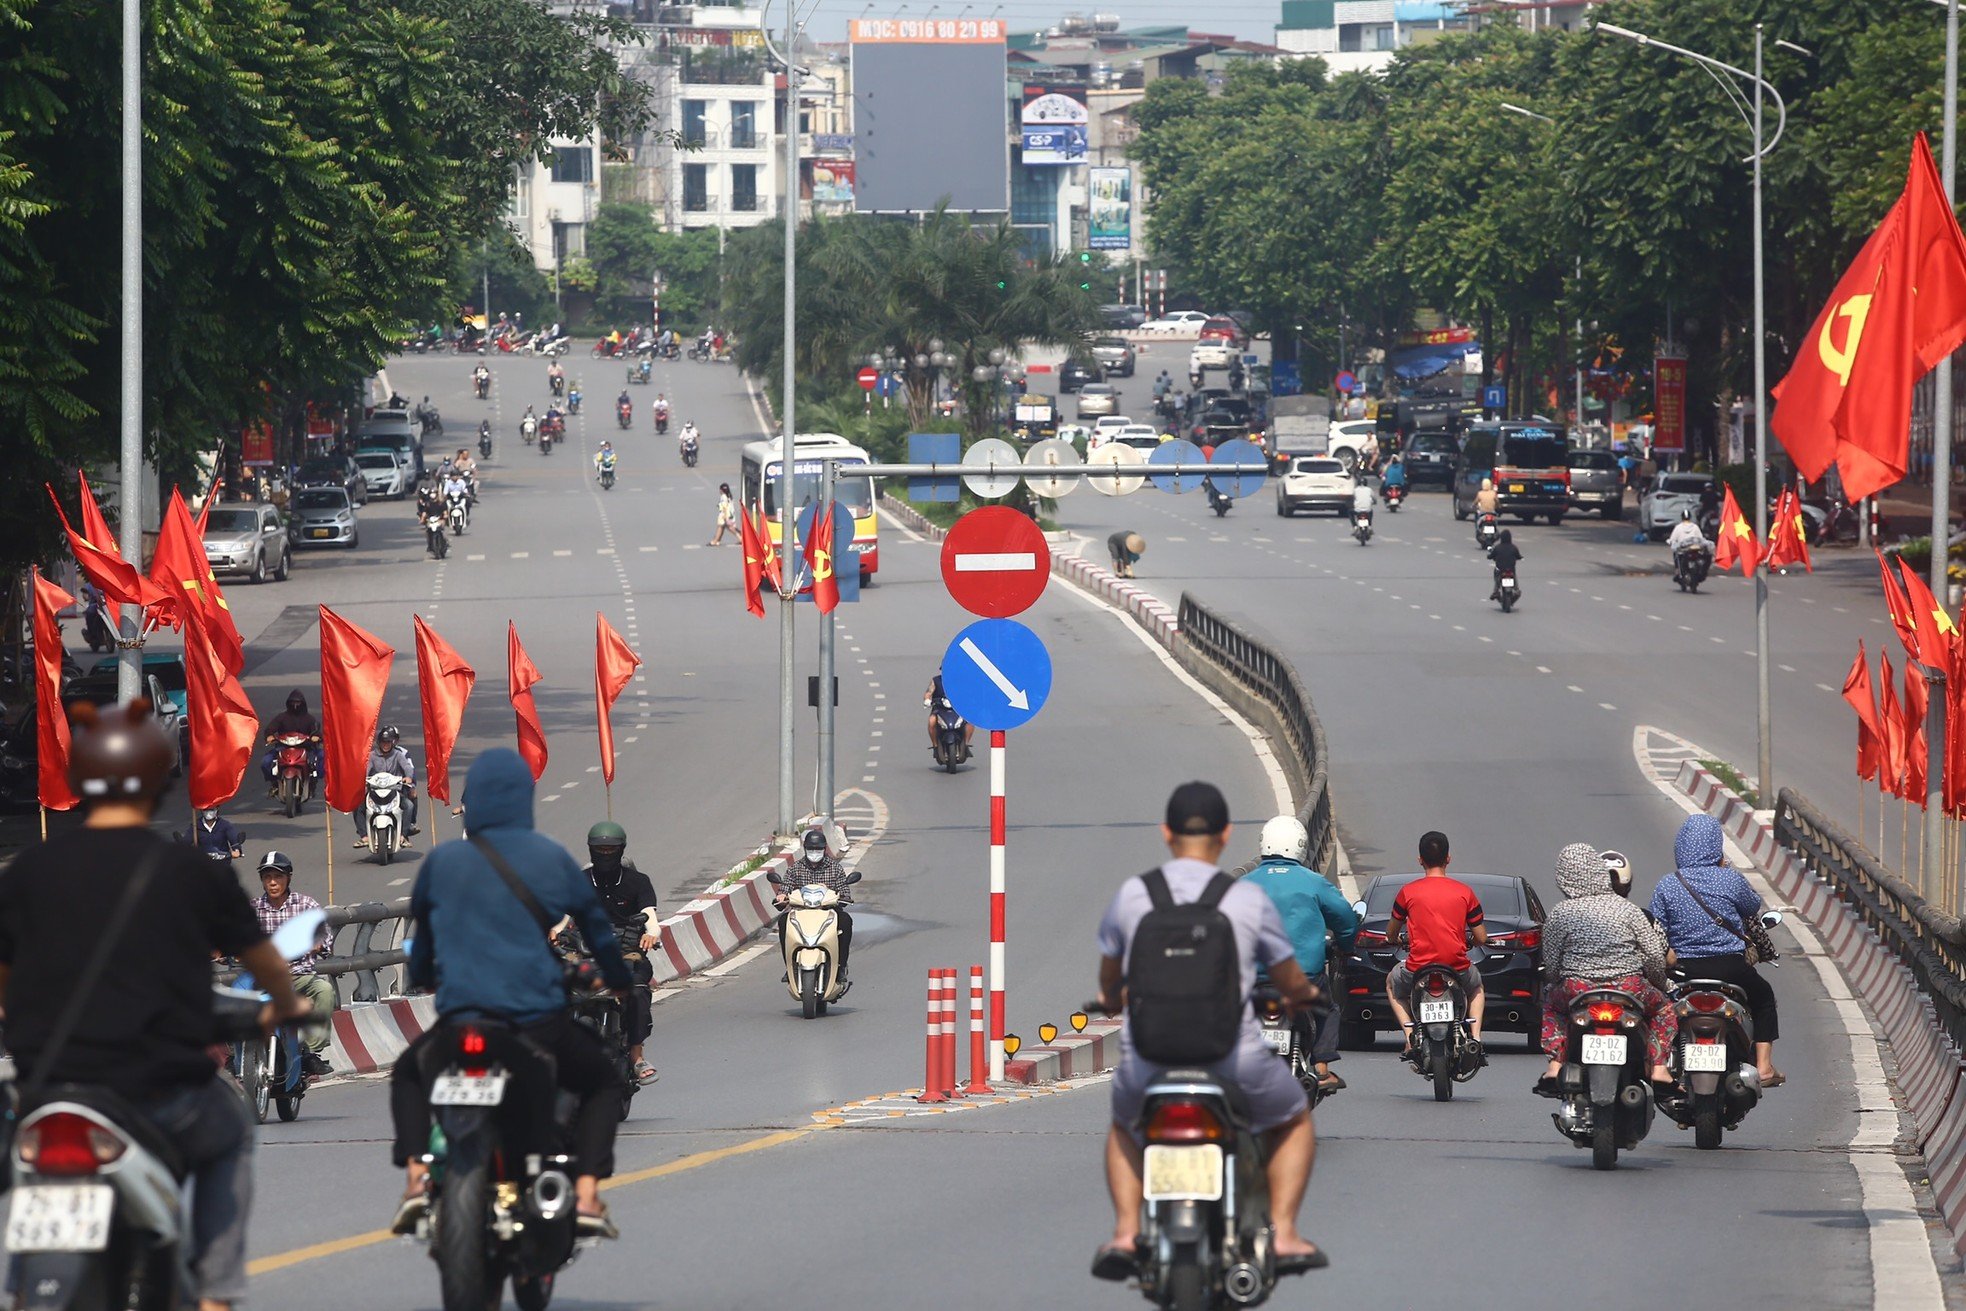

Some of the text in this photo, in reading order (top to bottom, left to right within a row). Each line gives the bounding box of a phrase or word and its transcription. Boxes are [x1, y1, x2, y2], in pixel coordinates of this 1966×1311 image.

[900, 20, 935, 38] 0916
[959, 20, 977, 38] 20
[980, 20, 999, 38] 99
[1424, 1002, 1449, 1012] 30-M1
[1424, 1012, 1449, 1021] 0363
[1261, 1030, 1285, 1041] 7-B3
[1585, 1050, 1623, 1062] 421.62
